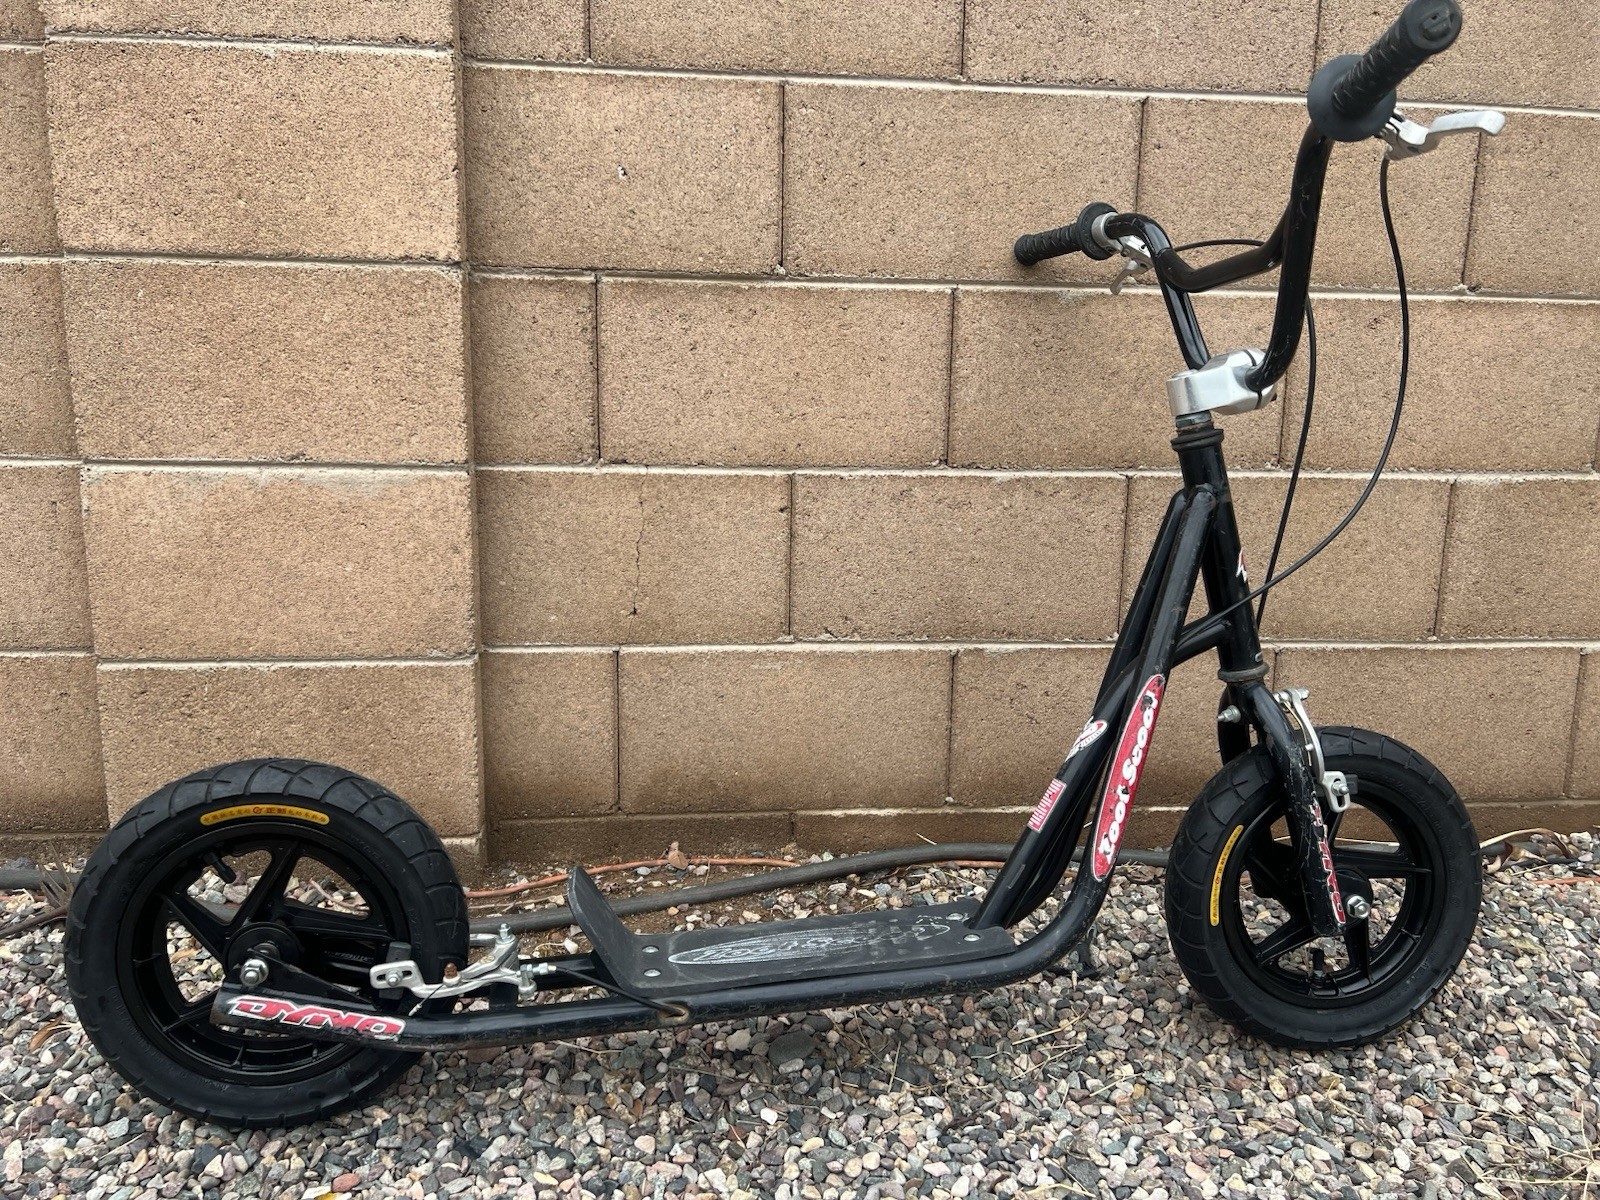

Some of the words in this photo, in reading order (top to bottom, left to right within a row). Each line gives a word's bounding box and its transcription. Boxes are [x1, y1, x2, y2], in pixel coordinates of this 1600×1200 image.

[1099, 783, 1131, 865] Zoot
[1122, 689, 1159, 787] Scoot
[227, 994, 406, 1042] DYNO
